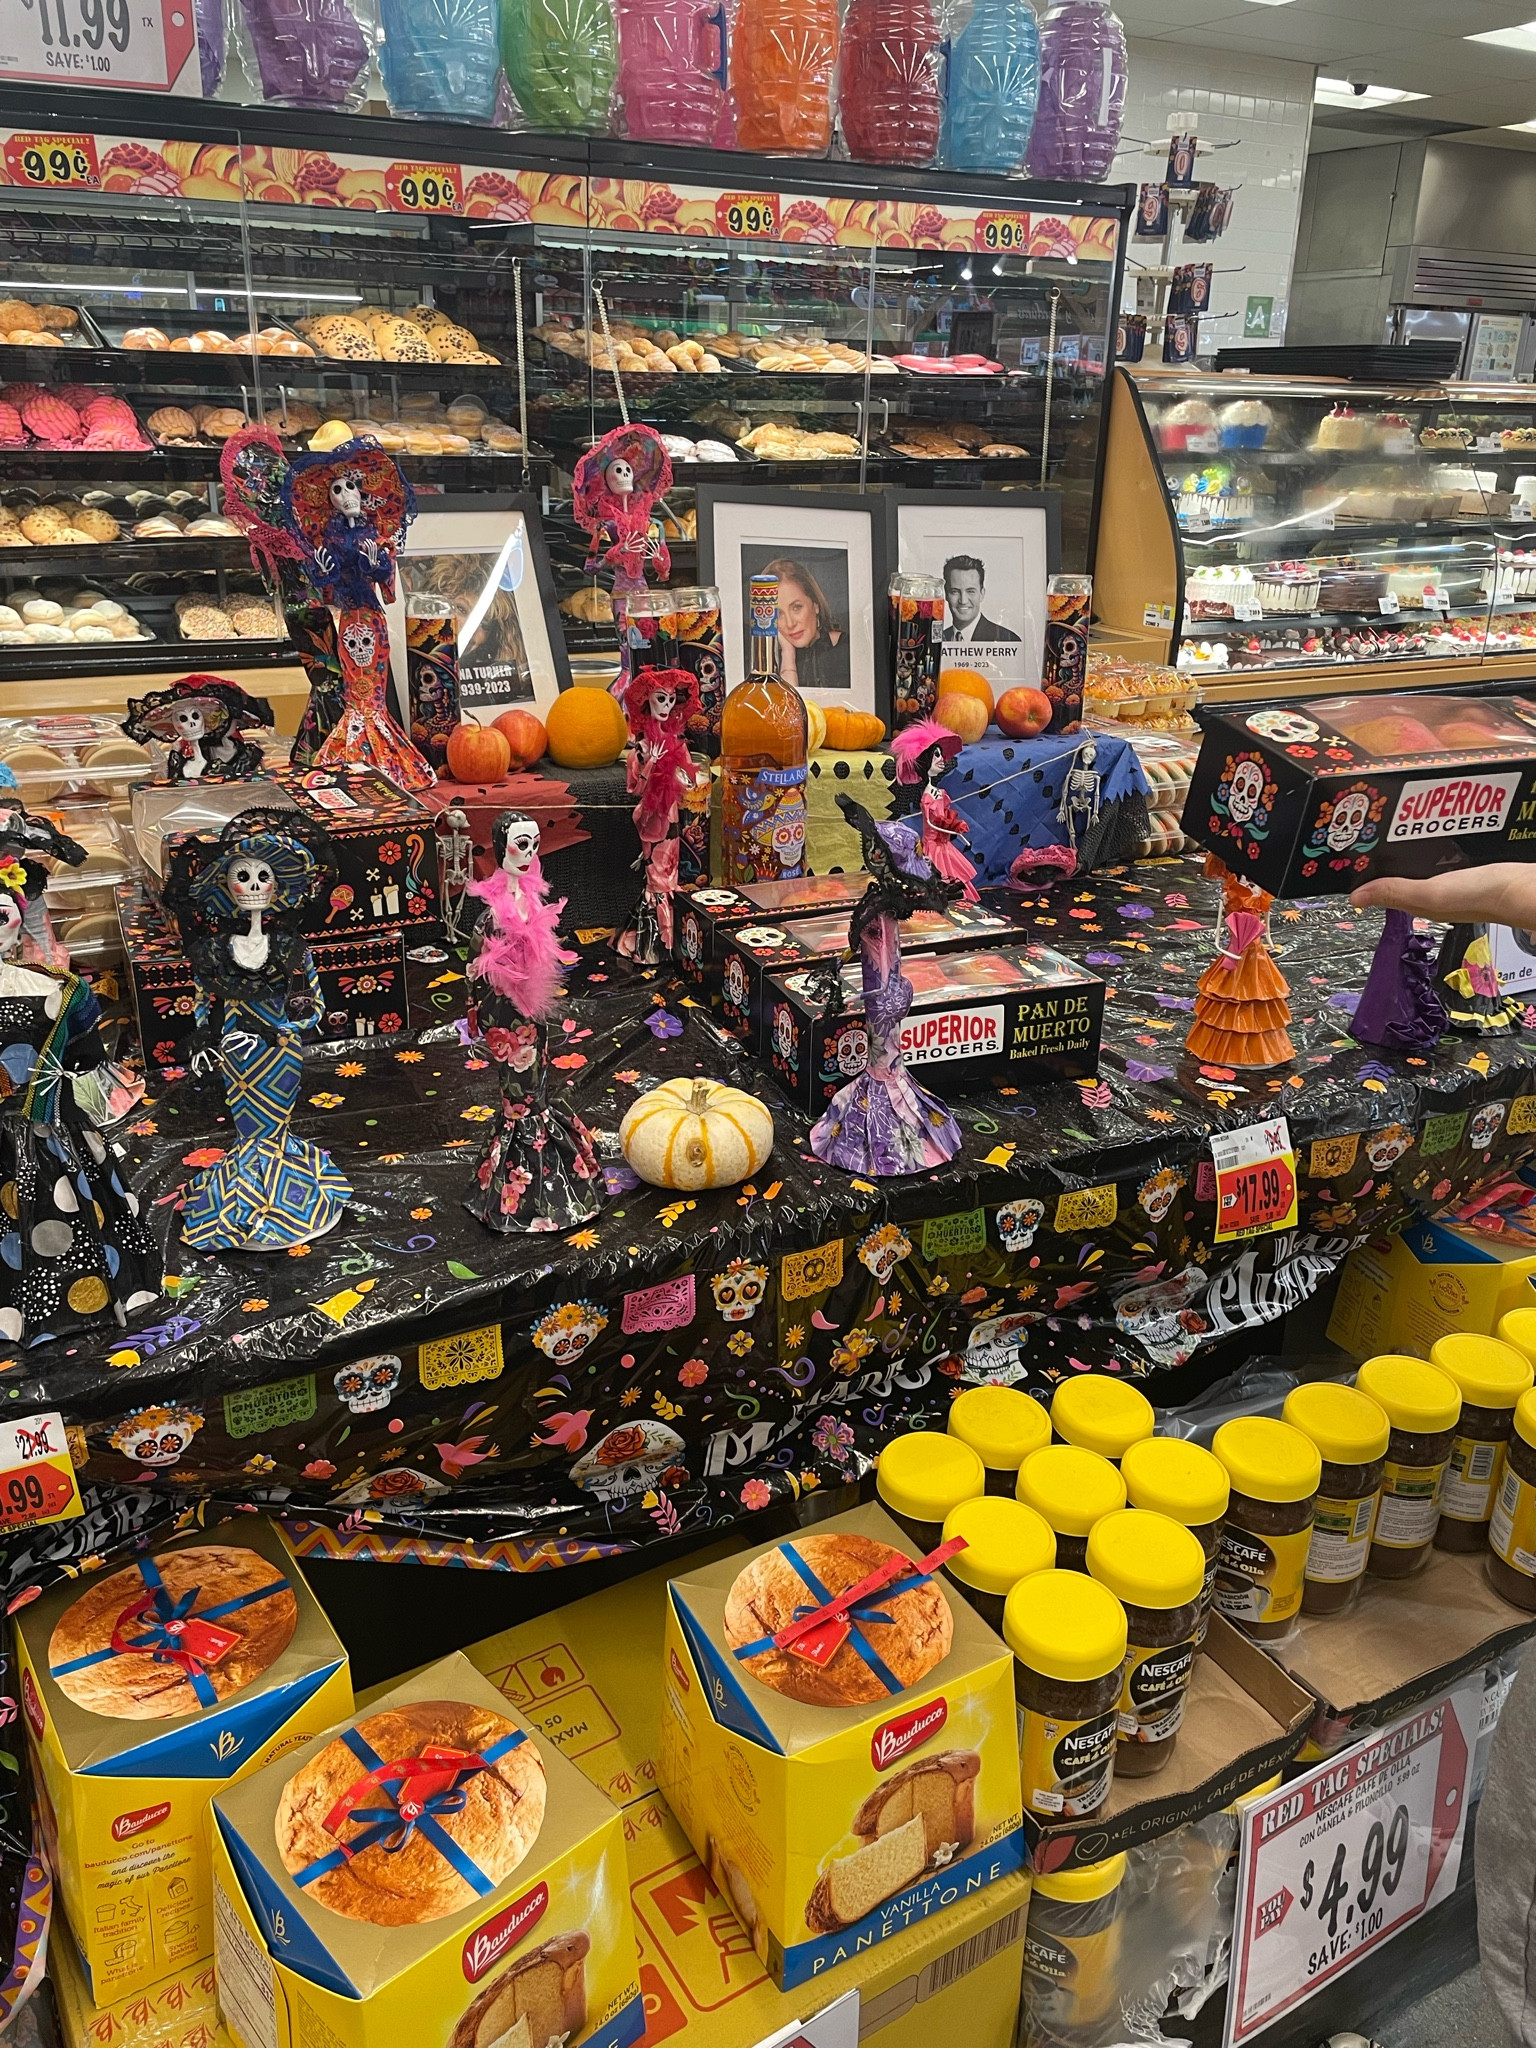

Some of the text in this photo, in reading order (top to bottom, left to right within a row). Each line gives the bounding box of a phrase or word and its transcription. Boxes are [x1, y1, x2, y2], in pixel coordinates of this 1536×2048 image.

[21, 0, 131, 52] 11.99
[46, 52, 111, 72] SAVE: $1.00
[24, 149, 88, 181] 99¢
[86, 175, 100, 184] EA
[401, 178, 454, 206] 99¢
[729, 206, 772, 232] 99¢
[986, 223, 1022, 247] 99¢
[1251, 305, 1266, 329] A
[941, 648, 1018, 657] ATTHEW PERRY
[460, 665, 512, 681] NA TURNER
[460, 681, 511, 697] 939-2023
[761, 769, 795, 785] STELLA
[1399, 781, 1506, 822] SUPERIOR
[1394, 814, 1500, 837] GROCERS
[1519, 966, 1533, 977] de
[1018, 996, 1089, 1022] PAN DE
[901, 1014, 997, 1050] SUPERIOR
[1012, 1017, 1091, 1045] MUERTO
[1009, 1038, 1091, 1060] Baked Fresh Daily
[1236, 1168, 1280, 1214] $17.99
[936, 1226, 975, 1239] MUERTOS
[1255, 1222, 1273, 1233] SPECIAL
[243, 1390, 297, 1410] MUERTOS
[15, 1430, 49, 1459] $21.99
[0, 1475, 44, 1517] .99
[0, 1518, 11, 1526] AVE
[8, 1520, 38, 1533] SPECIAL
[1221, 1540, 1267, 1562] ESCAFÉ
[1240, 1564, 1264, 1575] Olla
[1382, 1690, 1426, 1718] TODO
[875, 1706, 944, 1766] Bauducco
[264, 1738, 293, 1764] NATURAL
[1260, 1706, 1445, 1840] RED TAG SPECIALS!
[1141, 1801, 1204, 1831] ORIGINAL
[1207, 1776, 1238, 1803] CAFÉ
[1239, 1767, 1254, 1783] DE
[1315, 1755, 1411, 1824] NESCAFE CAFE DE OLLA
[115, 1807, 168, 1837] Bauducco
[992, 1812, 1021, 1833] NET WT.
[1300, 1832, 1316, 1848] CON
[1316, 1815, 1346, 1842] CANELA
[1355, 1780, 1393, 1816] PILONCILLO
[132, 1841, 145, 1849] Go
[980, 1819, 1022, 1848] 24.0 oz (680g)
[84, 1835, 193, 1869] bauducco.com/panettone
[97, 1879, 122, 1889] magic
[124, 1876, 134, 1885] of
[152, 1857, 191, 1874] Panettone
[112, 1866, 127, 1876] and
[129, 1857, 160, 1872] discover
[1300, 1805, 1409, 1938] $4.99
[157, 1896, 194, 1914] Delicious
[162, 1903, 191, 1918] recipes
[880, 1881, 941, 1920] VANILLA
[1260, 1892, 1286, 1917] YOU
[94, 1915, 146, 1934] Italian family
[812, 1861, 1001, 1975] PANETTONE
[1260, 1908, 1282, 1930] PAY
[103, 1925, 138, 1938] tradition
[169, 1936, 197, 1951] Special
[466, 1891, 545, 1977] Bauducco
[1308, 1907, 1383, 1975] SAVE: $1.00
[170, 1943, 198, 1957] baking
[1025, 1941, 1067, 1964] SCAFÉ
[101, 1966, 144, 1985] panettone
[106, 1965, 128, 1976] What
[1040, 1964, 1066, 1977] Olla
[594, 1985, 640, 2030] 24.0 oz (680g)
[607, 1981, 637, 2010] NET WT.
